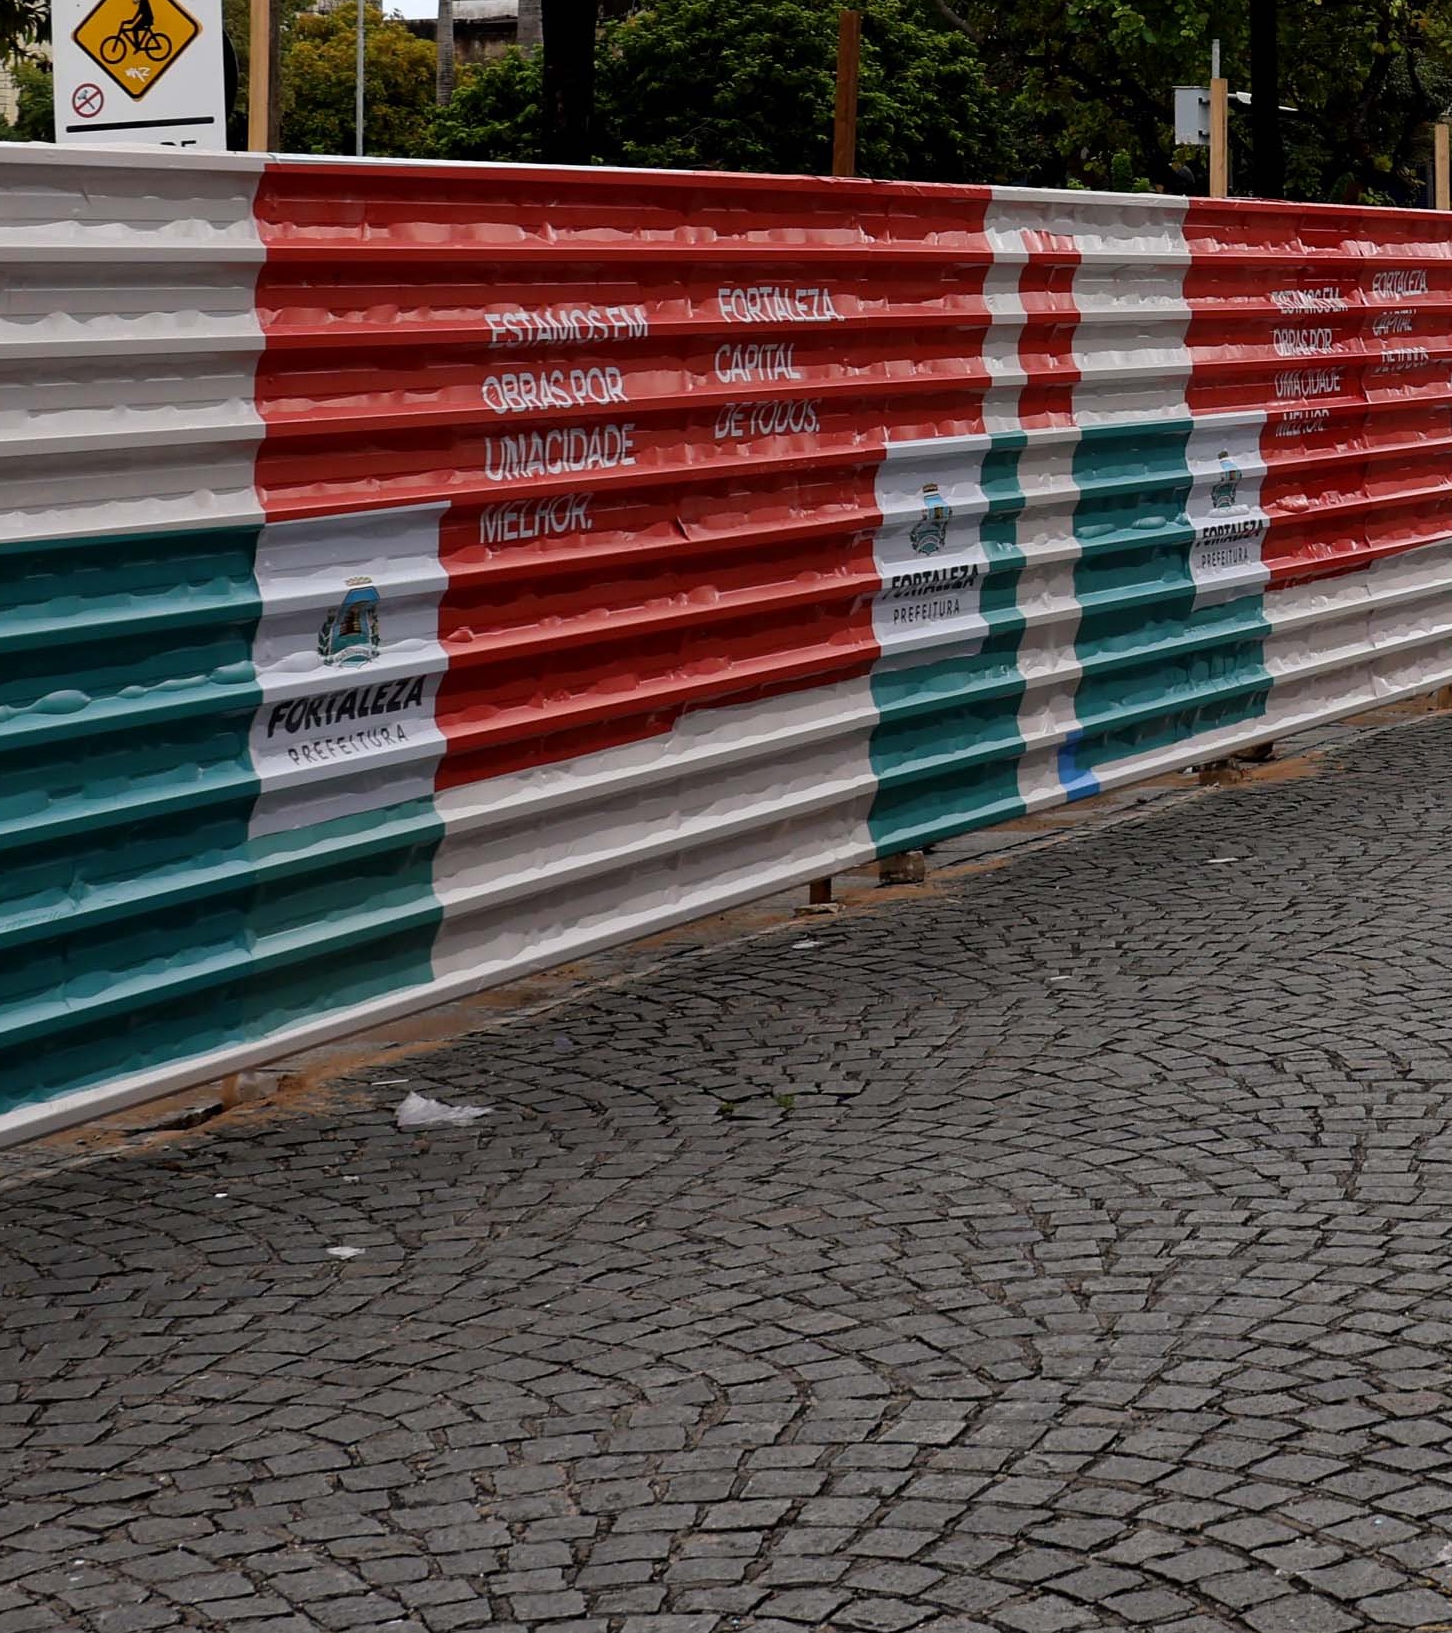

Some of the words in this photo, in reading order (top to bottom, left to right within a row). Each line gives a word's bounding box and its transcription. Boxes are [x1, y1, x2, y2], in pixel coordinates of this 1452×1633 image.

[484, 305, 608, 349] ESTAMOS
[605, 304, 649, 342] EM
[717, 286, 846, 324] FORTALEZA.
[714, 343, 802, 384] CAPITAL
[482, 370, 574, 414] OBRAS
[570, 367, 629, 406] POR
[714, 402, 744, 439] DE
[745, 398, 821, 438] TODOS.
[484, 431, 548, 481] UMA
[546, 423, 636, 475] CIDADE
[479, 492, 594, 544] MELHOR.
[1200, 546, 1249, 570] PREFEITURA
[892, 598, 961, 625] PREFEITURA
[267, 674, 428, 738] FORTALEZA
[288, 723, 408, 766] PREFEITURA
